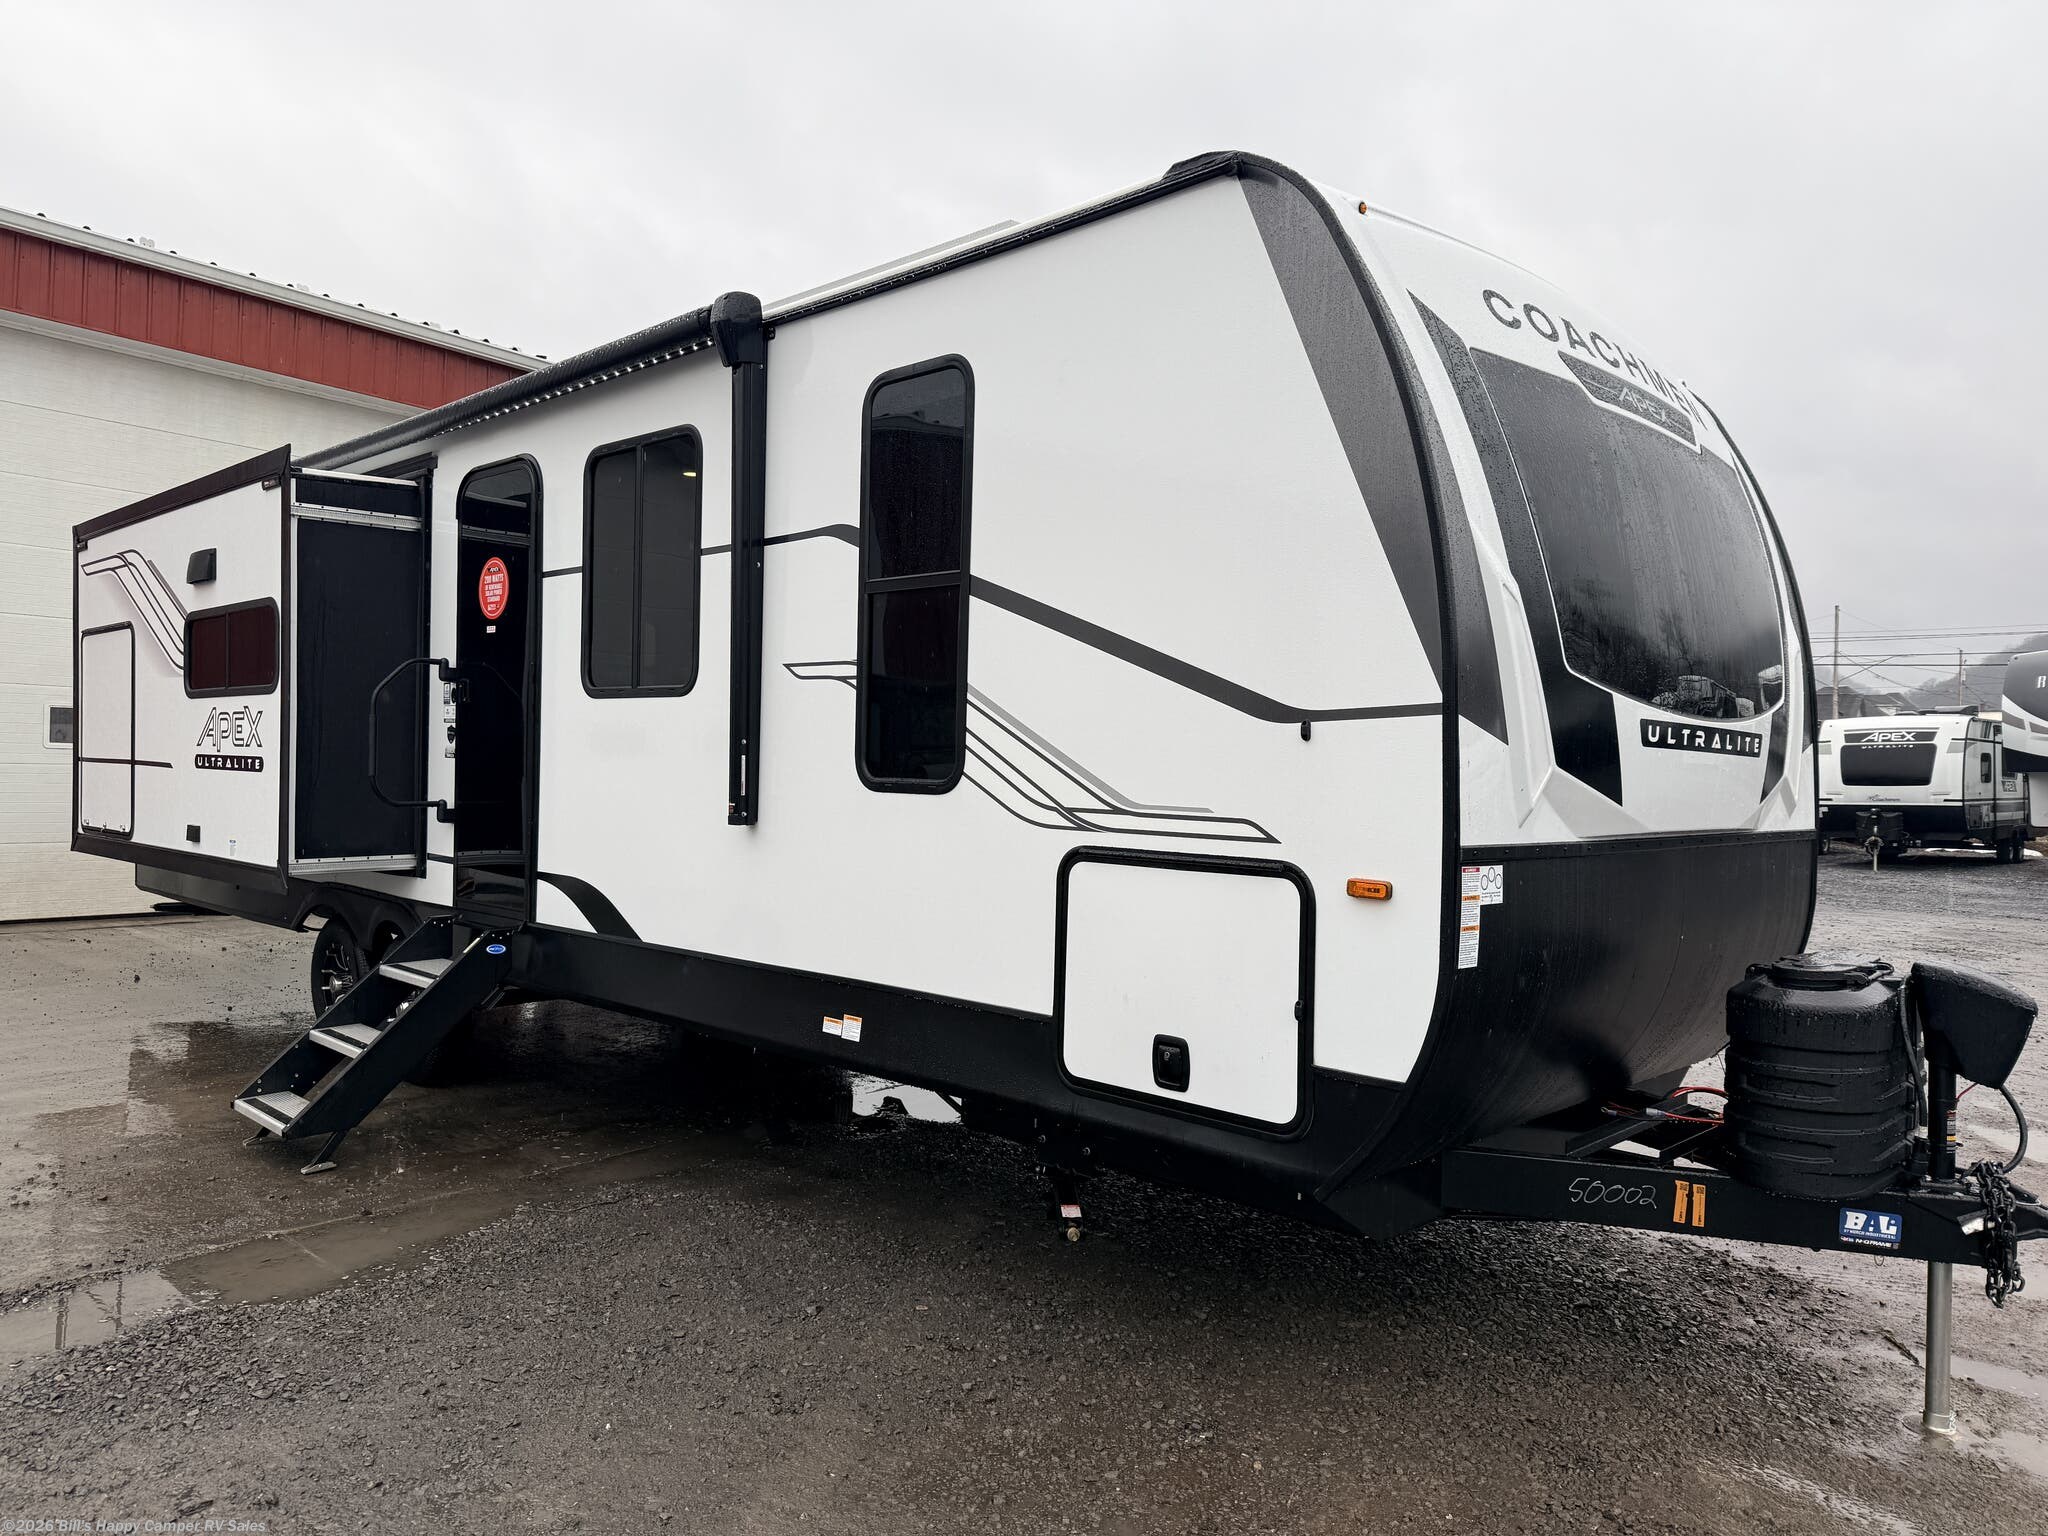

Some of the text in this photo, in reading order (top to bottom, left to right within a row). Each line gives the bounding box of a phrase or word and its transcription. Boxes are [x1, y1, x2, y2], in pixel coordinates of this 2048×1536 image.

[196, 705, 264, 753] APEX
[1647, 724, 1761, 754] ULTRALITE
[1860, 731, 1917, 743] APEX
[197, 756, 261, 770] ULTRALITE
[1568, 1177, 1658, 1210] 50002
[1844, 1211, 1898, 1235] BAL
